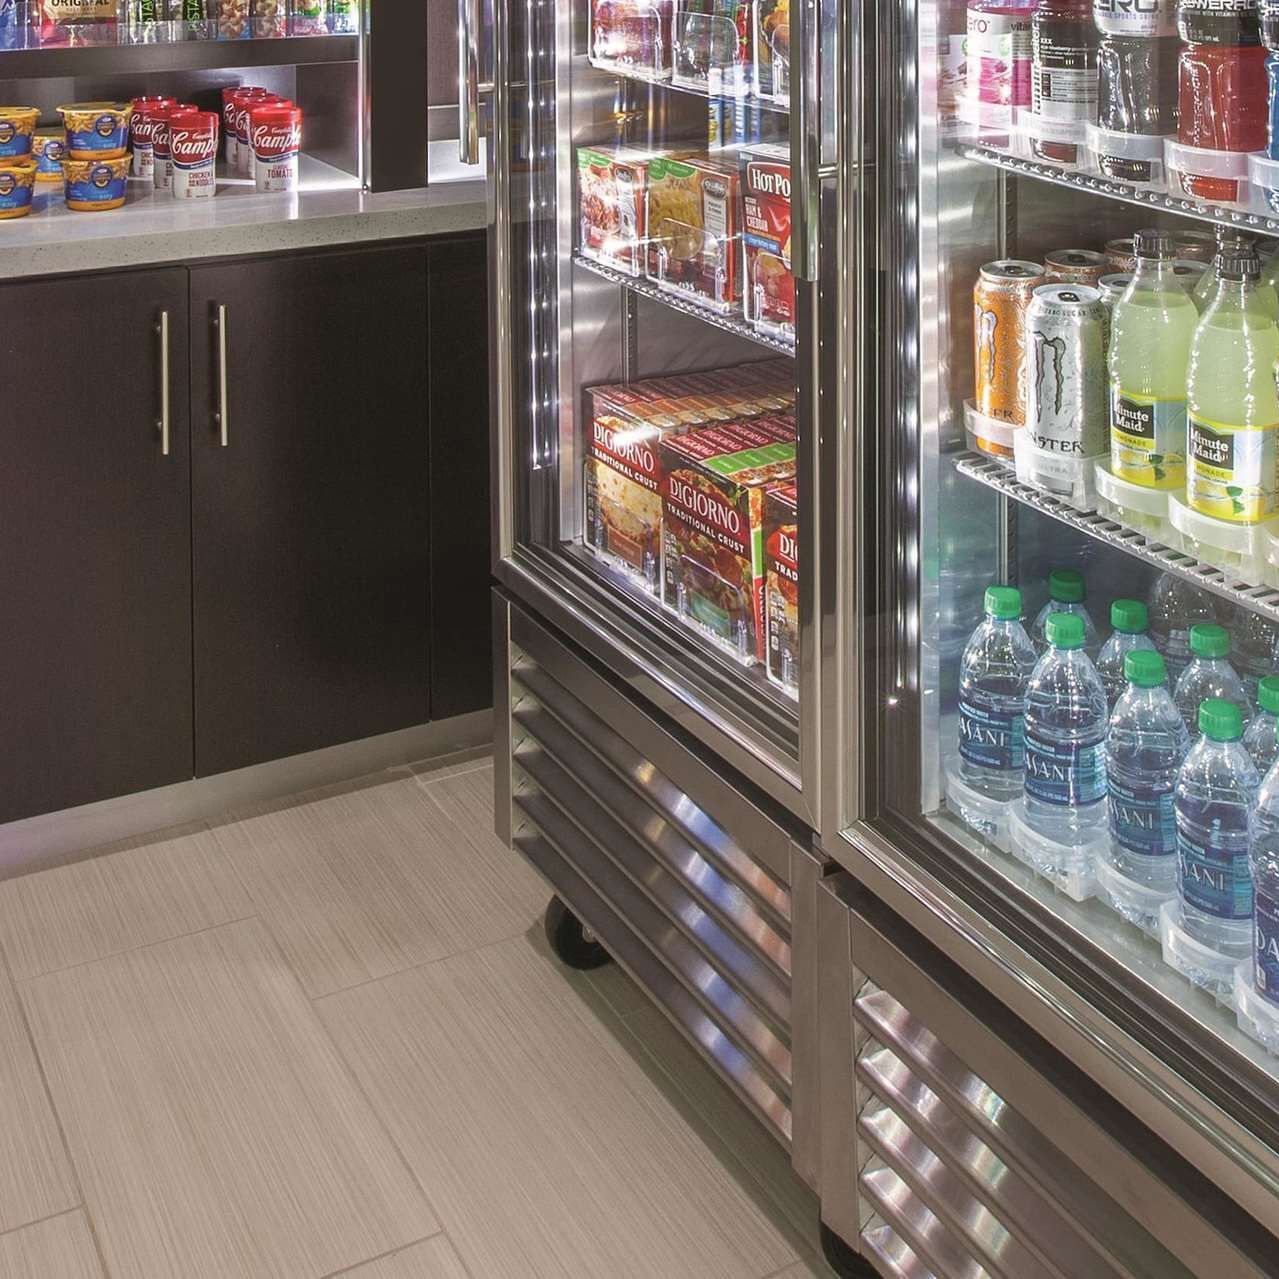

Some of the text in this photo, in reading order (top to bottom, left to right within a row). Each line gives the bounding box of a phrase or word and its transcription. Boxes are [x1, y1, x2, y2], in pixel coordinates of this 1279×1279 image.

[752, 168, 774, 193] HOT
[1114, 402, 1149, 423] Minute
[1190, 426, 1229, 453] Minute
[592, 447, 658, 491] TRADITIONAL CRUST
[669, 477, 740, 534] DIGIORNO
[667, 502, 745, 555] TRADITIONAL CRUST
[960, 717, 1005, 747] ASANI
[1025, 751, 1072, 782] ASANI
